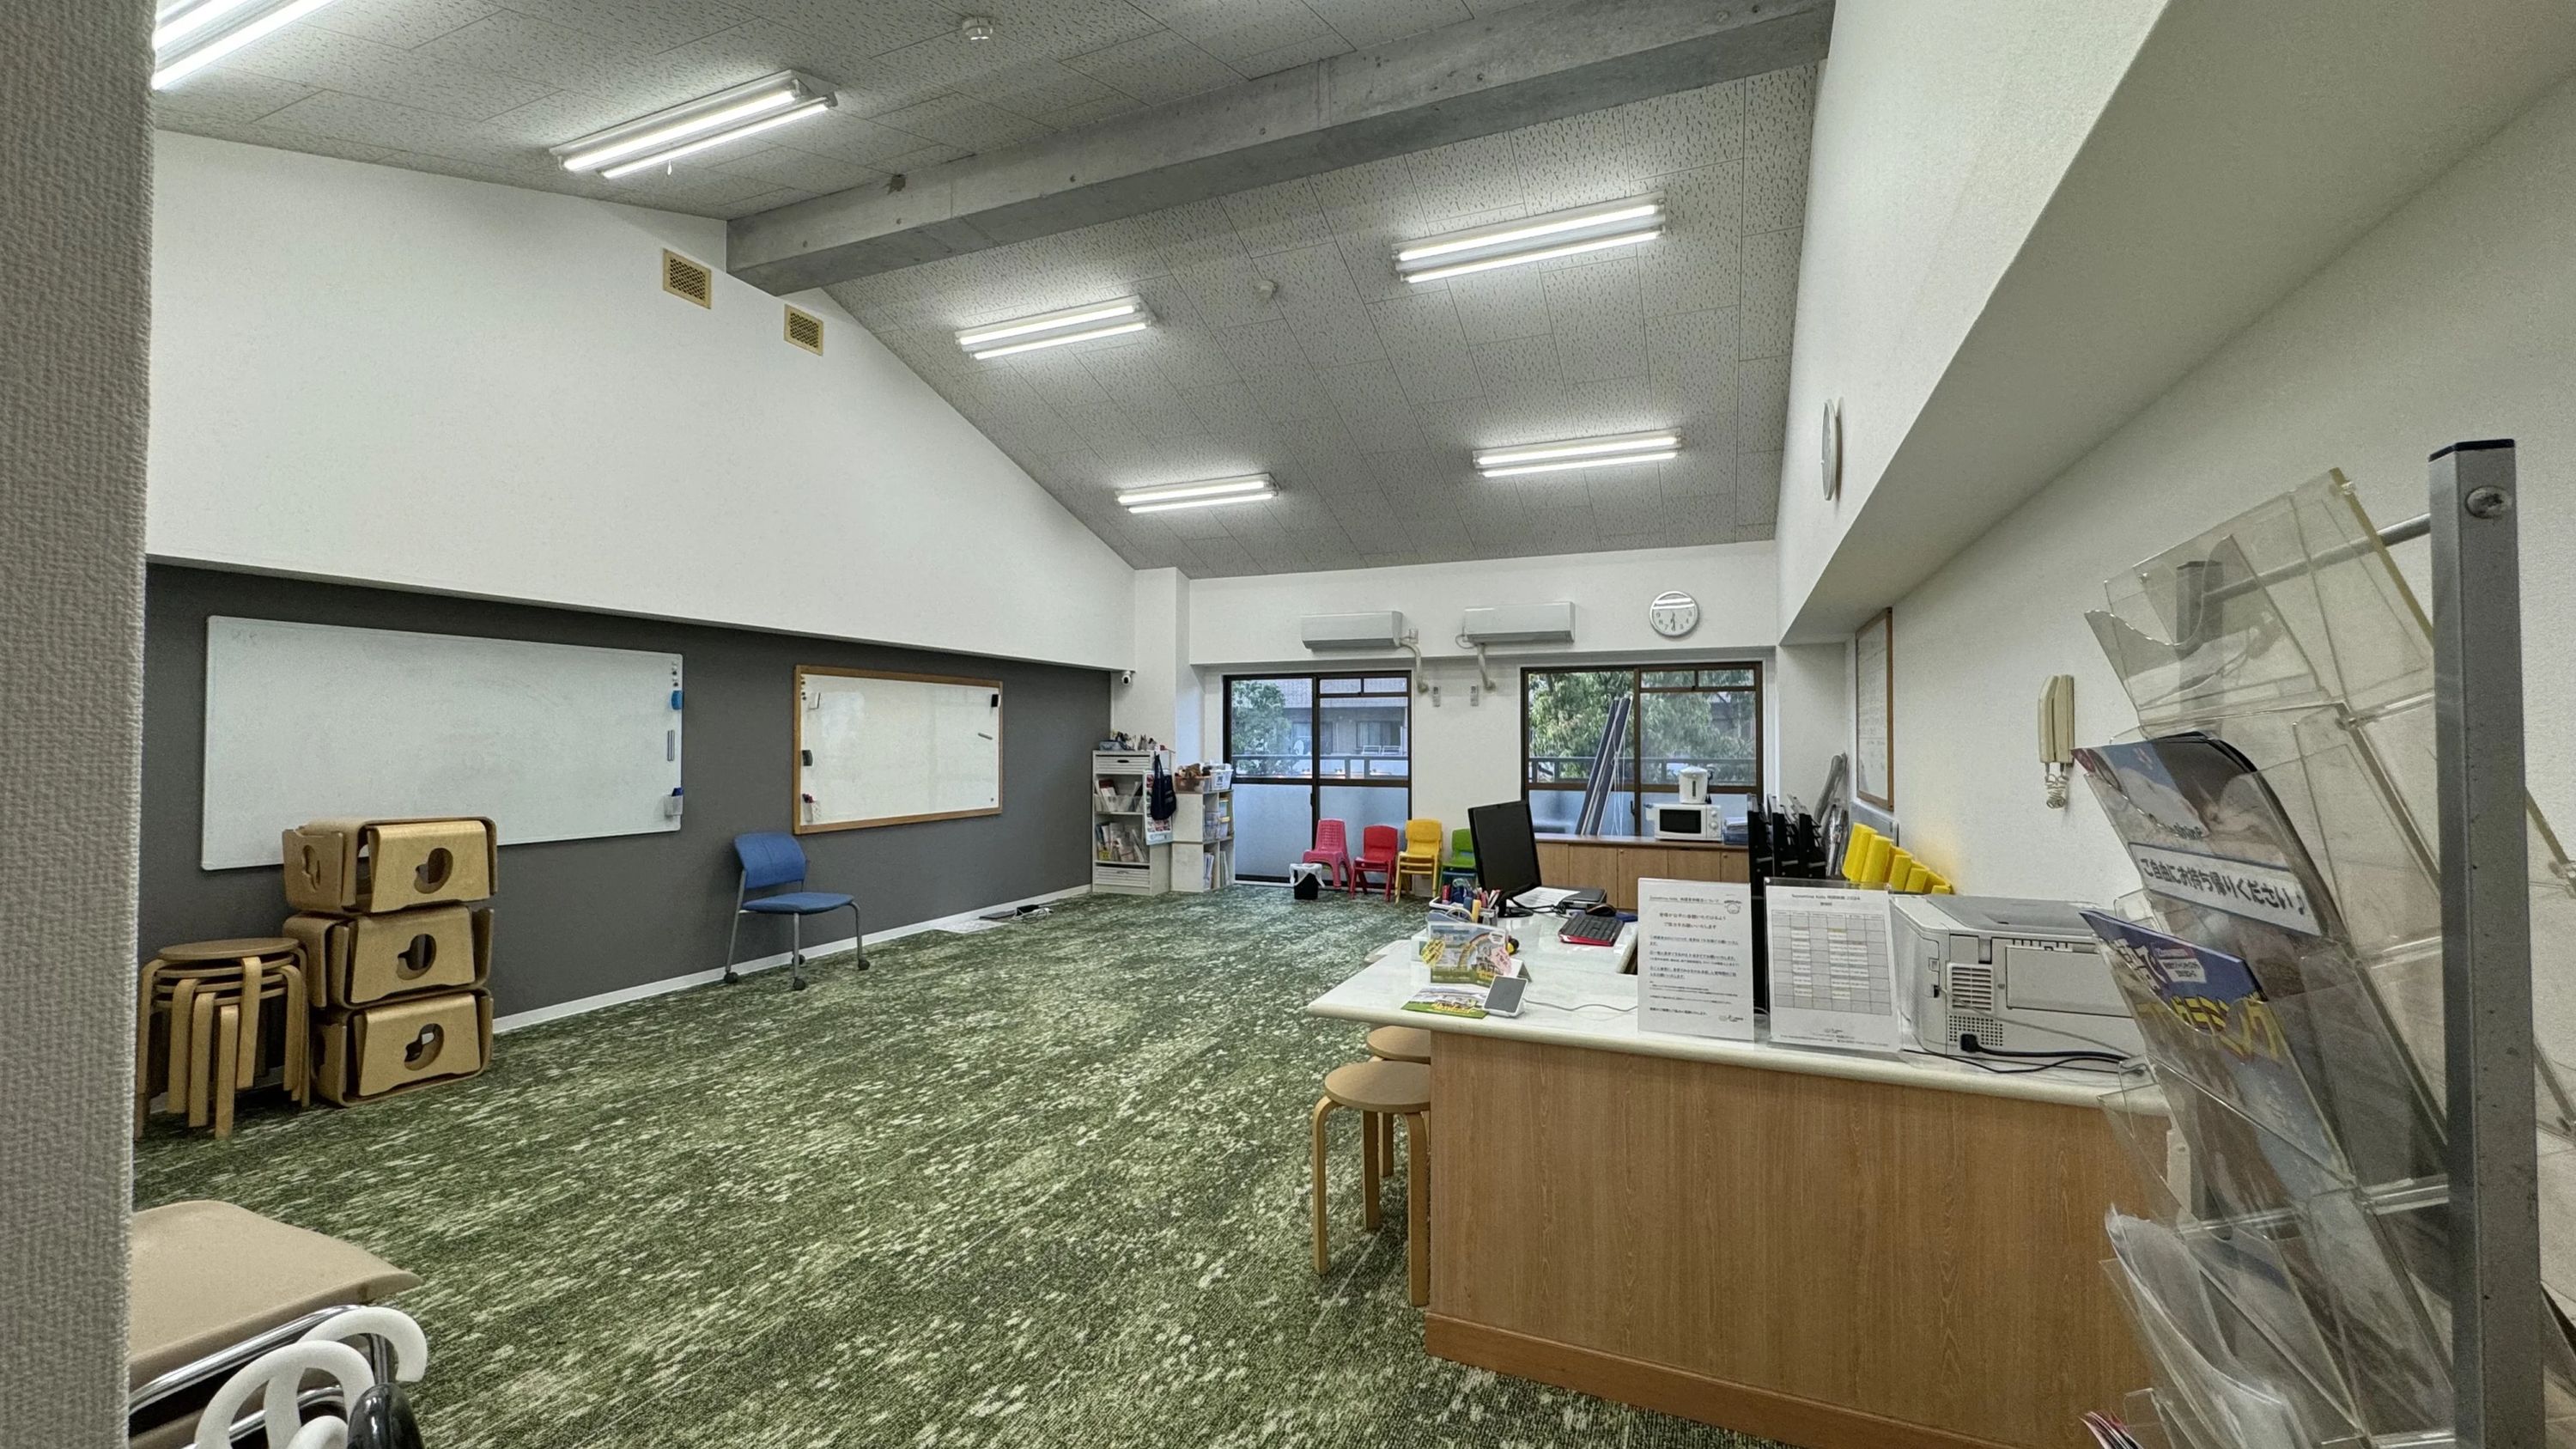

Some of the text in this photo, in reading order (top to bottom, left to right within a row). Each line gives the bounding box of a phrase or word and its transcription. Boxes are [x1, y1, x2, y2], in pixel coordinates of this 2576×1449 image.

[2140, 857, 2294, 910] ご自由にお持ち帰りください
